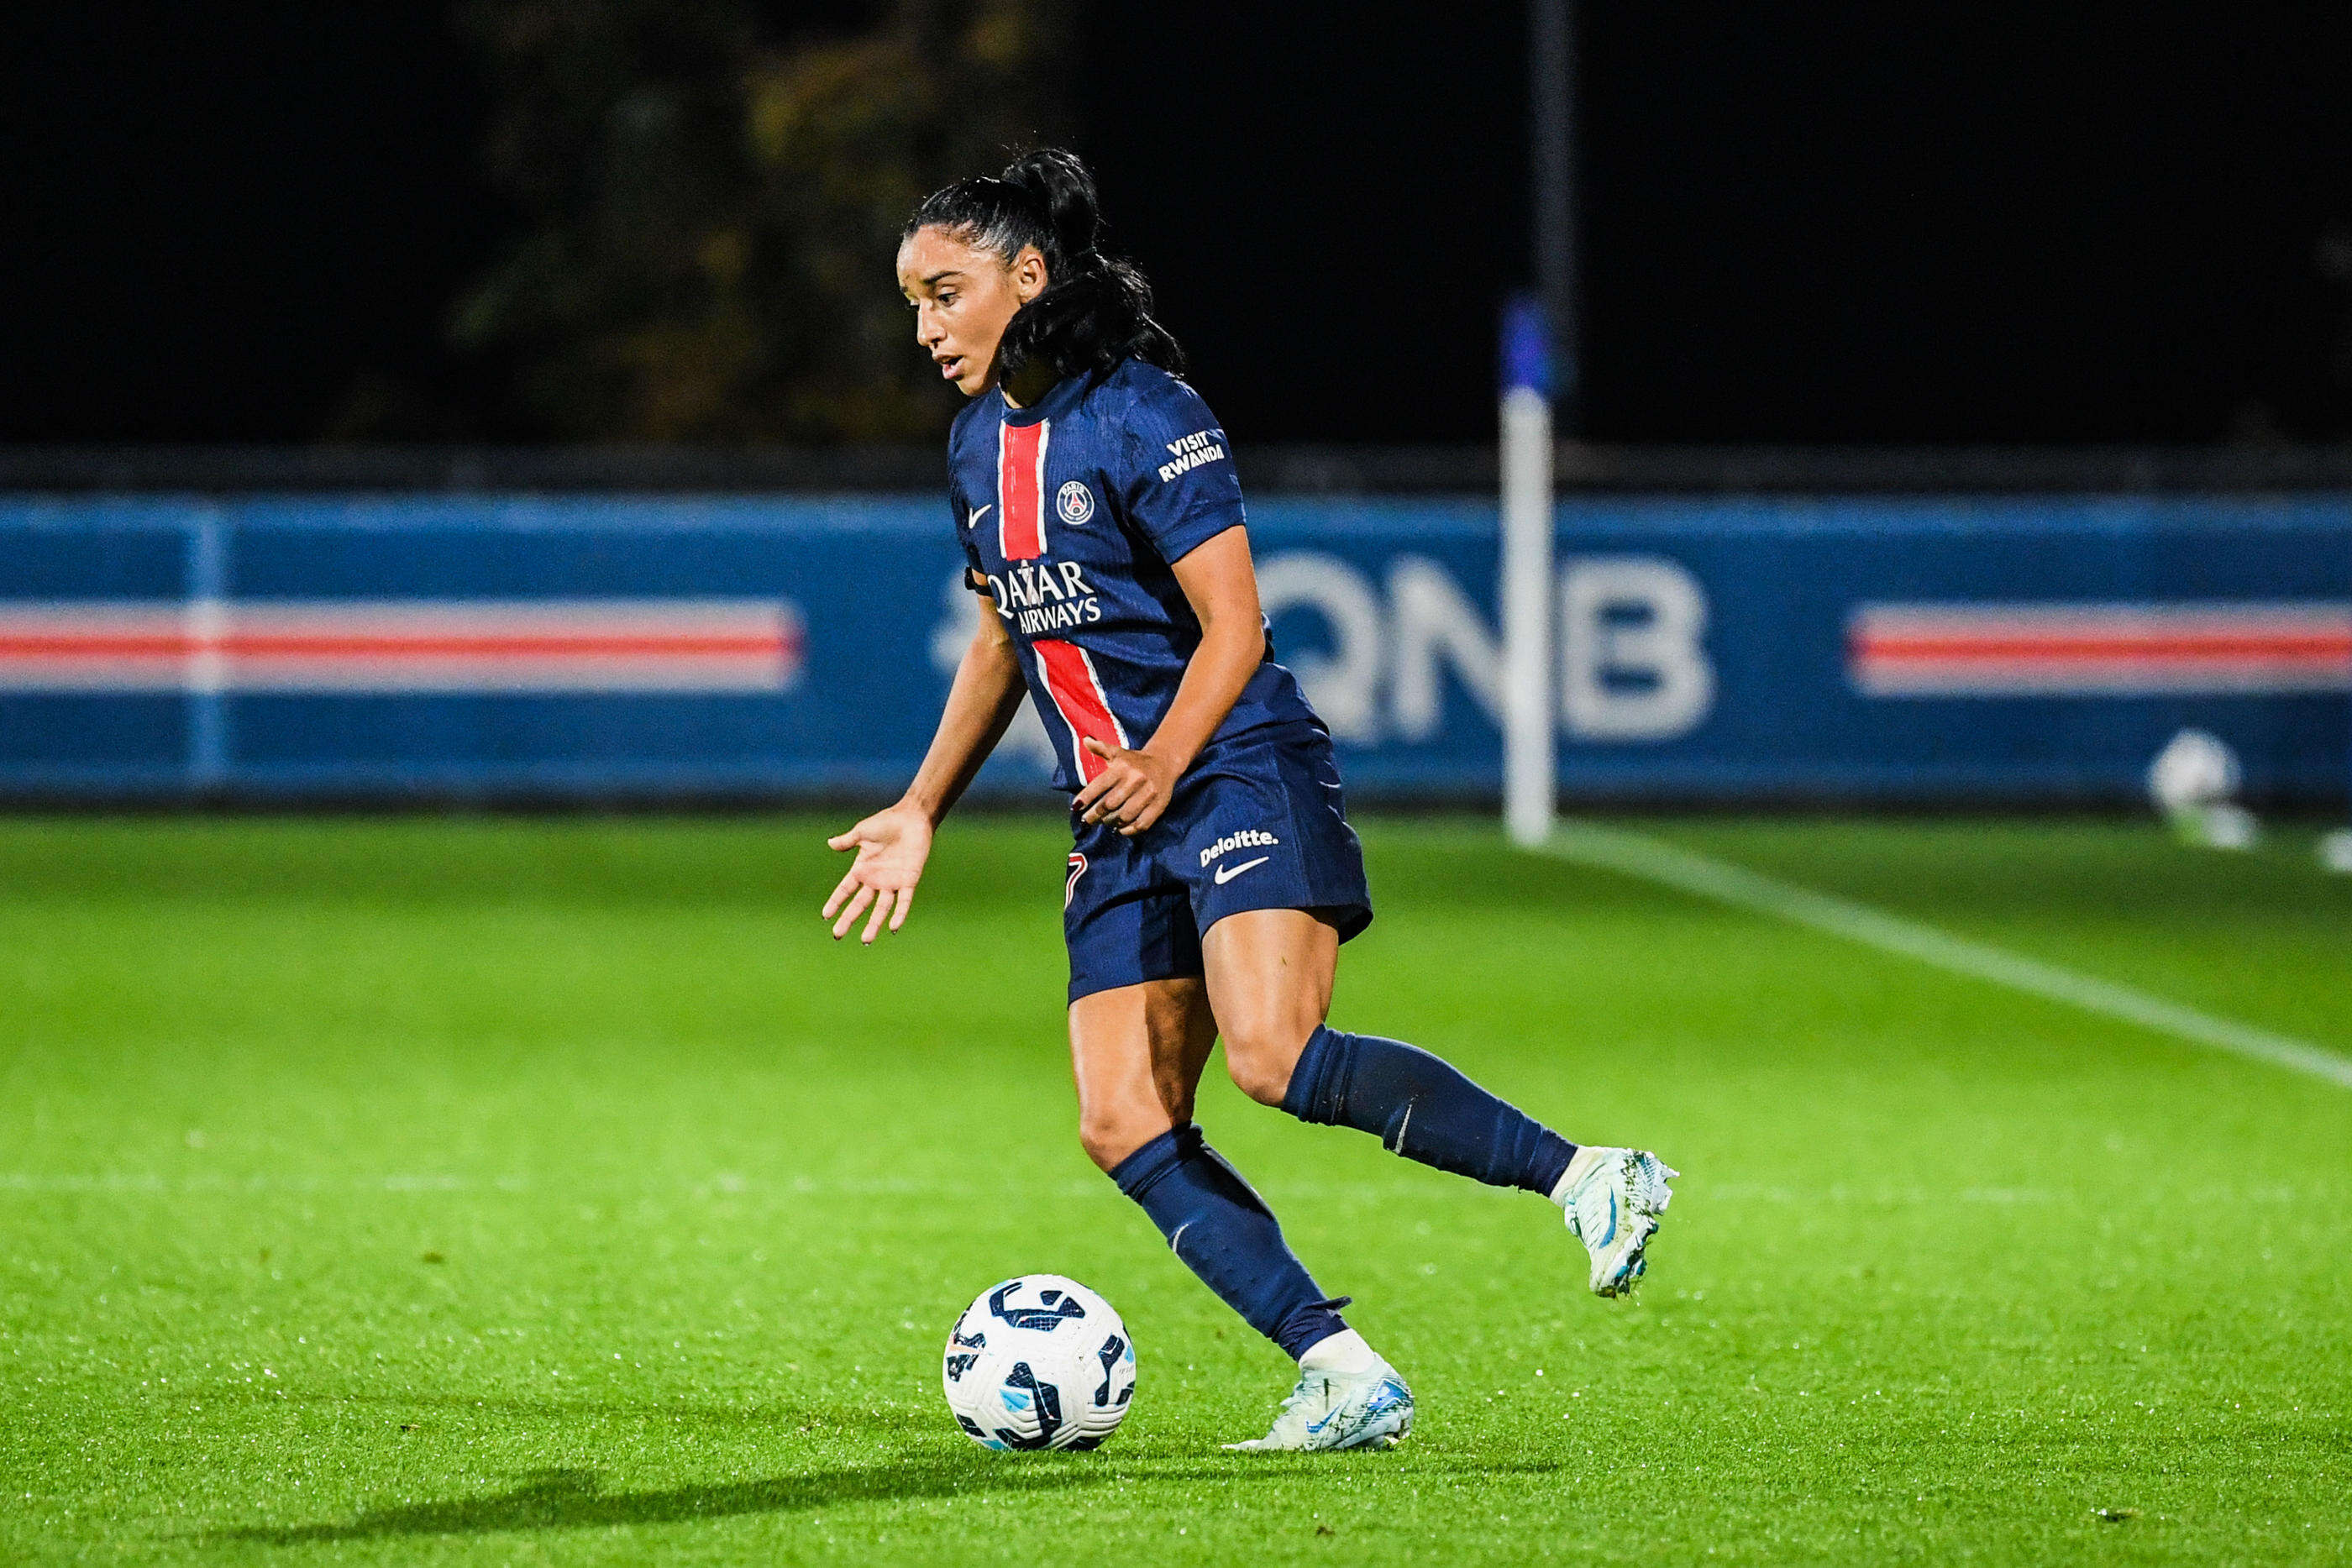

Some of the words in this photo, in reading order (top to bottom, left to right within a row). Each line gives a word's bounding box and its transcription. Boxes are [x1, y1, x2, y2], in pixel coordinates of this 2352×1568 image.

[1158, 443, 1225, 482] RWANDA
[1166, 430, 1209, 456] VISIT
[1061, 483, 1084, 496] PARIS
[987, 560, 1095, 620] QATAR
[1018, 596, 1101, 634] AIRWAYS
[1258, 553, 1715, 746] QNB
[1200, 829, 1279, 868] Deloitte.
[1064, 852, 1089, 911] 7
